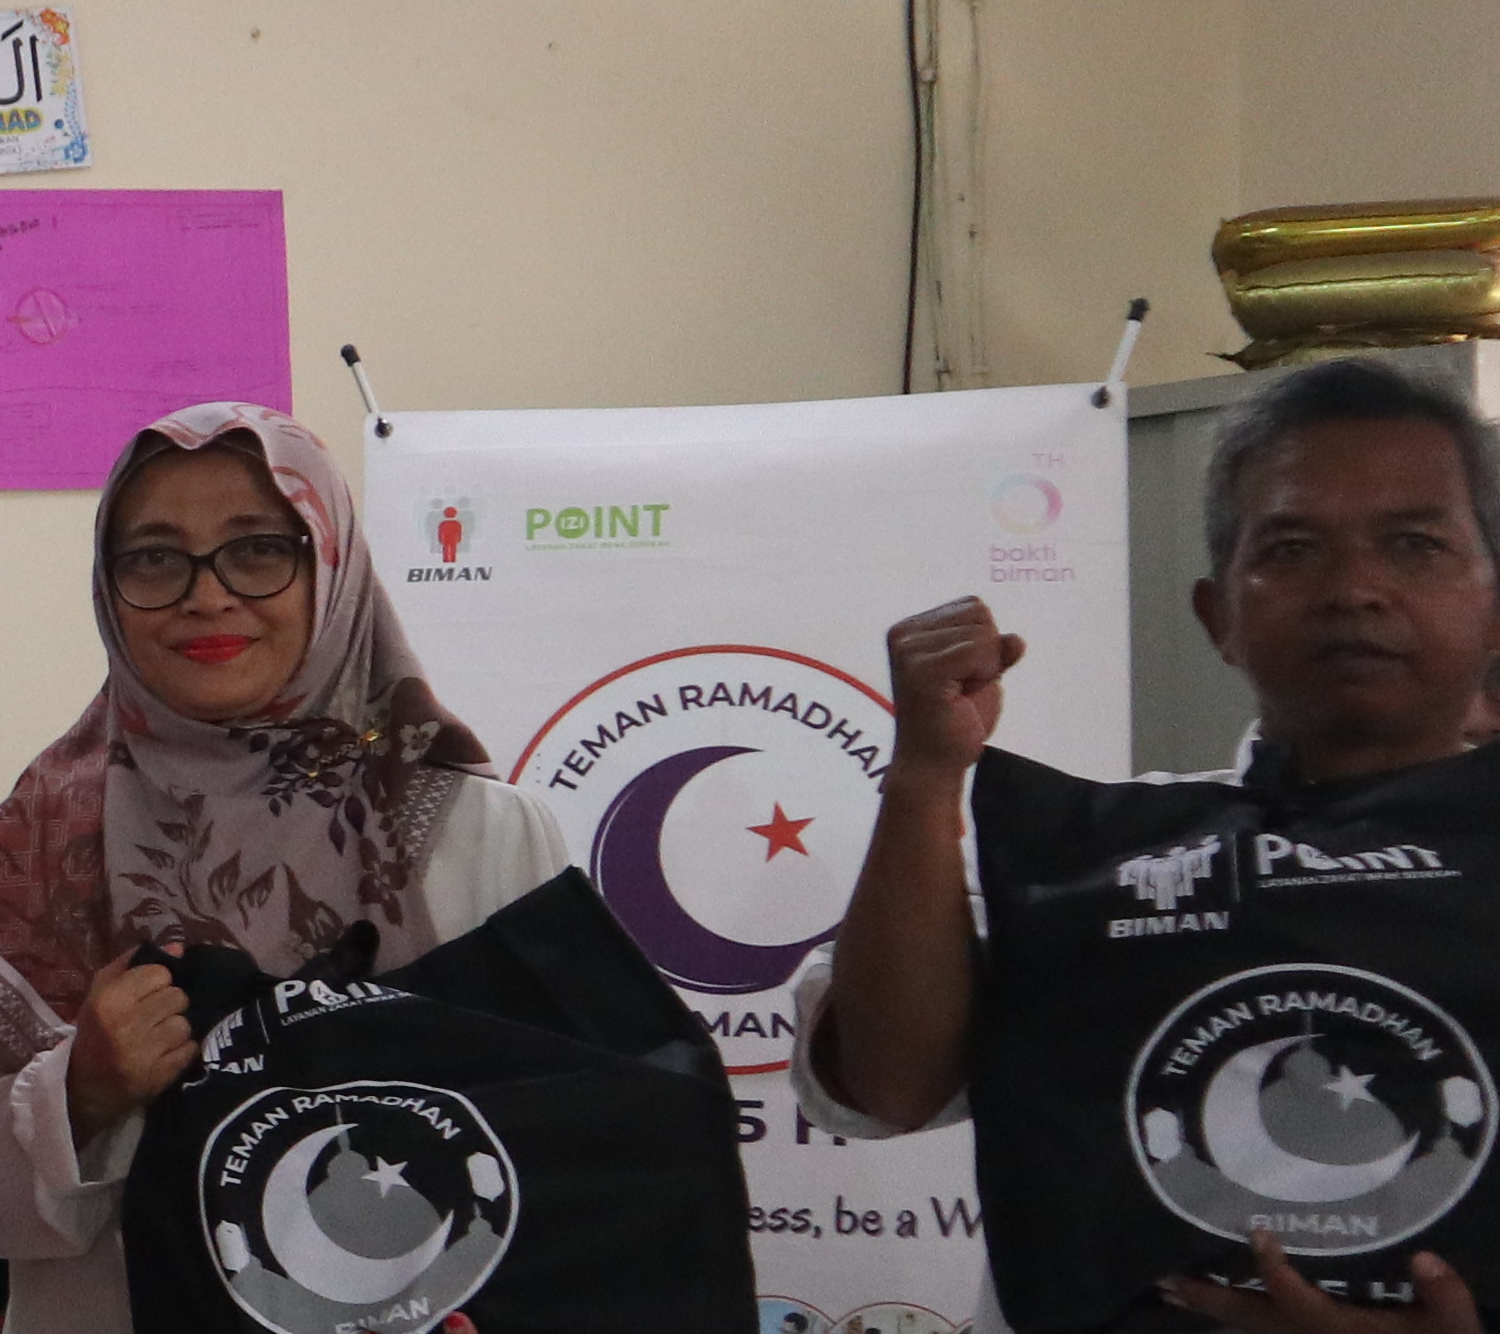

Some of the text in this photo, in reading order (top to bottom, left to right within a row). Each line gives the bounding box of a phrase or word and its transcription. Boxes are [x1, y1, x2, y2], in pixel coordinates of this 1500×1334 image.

[525, 503, 671, 541] POINT
[407, 566, 493, 582] BIMAN
[548, 693, 668, 792] TEMAN
[1107, 912, 1230, 939] BIMAN
[1162, 990, 1445, 1078] TEMAN RAMADHAN
[220, 1092, 463, 1188] TEMAN RAMADHAN
[835, 1195, 883, 1235] be
[896, 1209, 917, 1237] a
